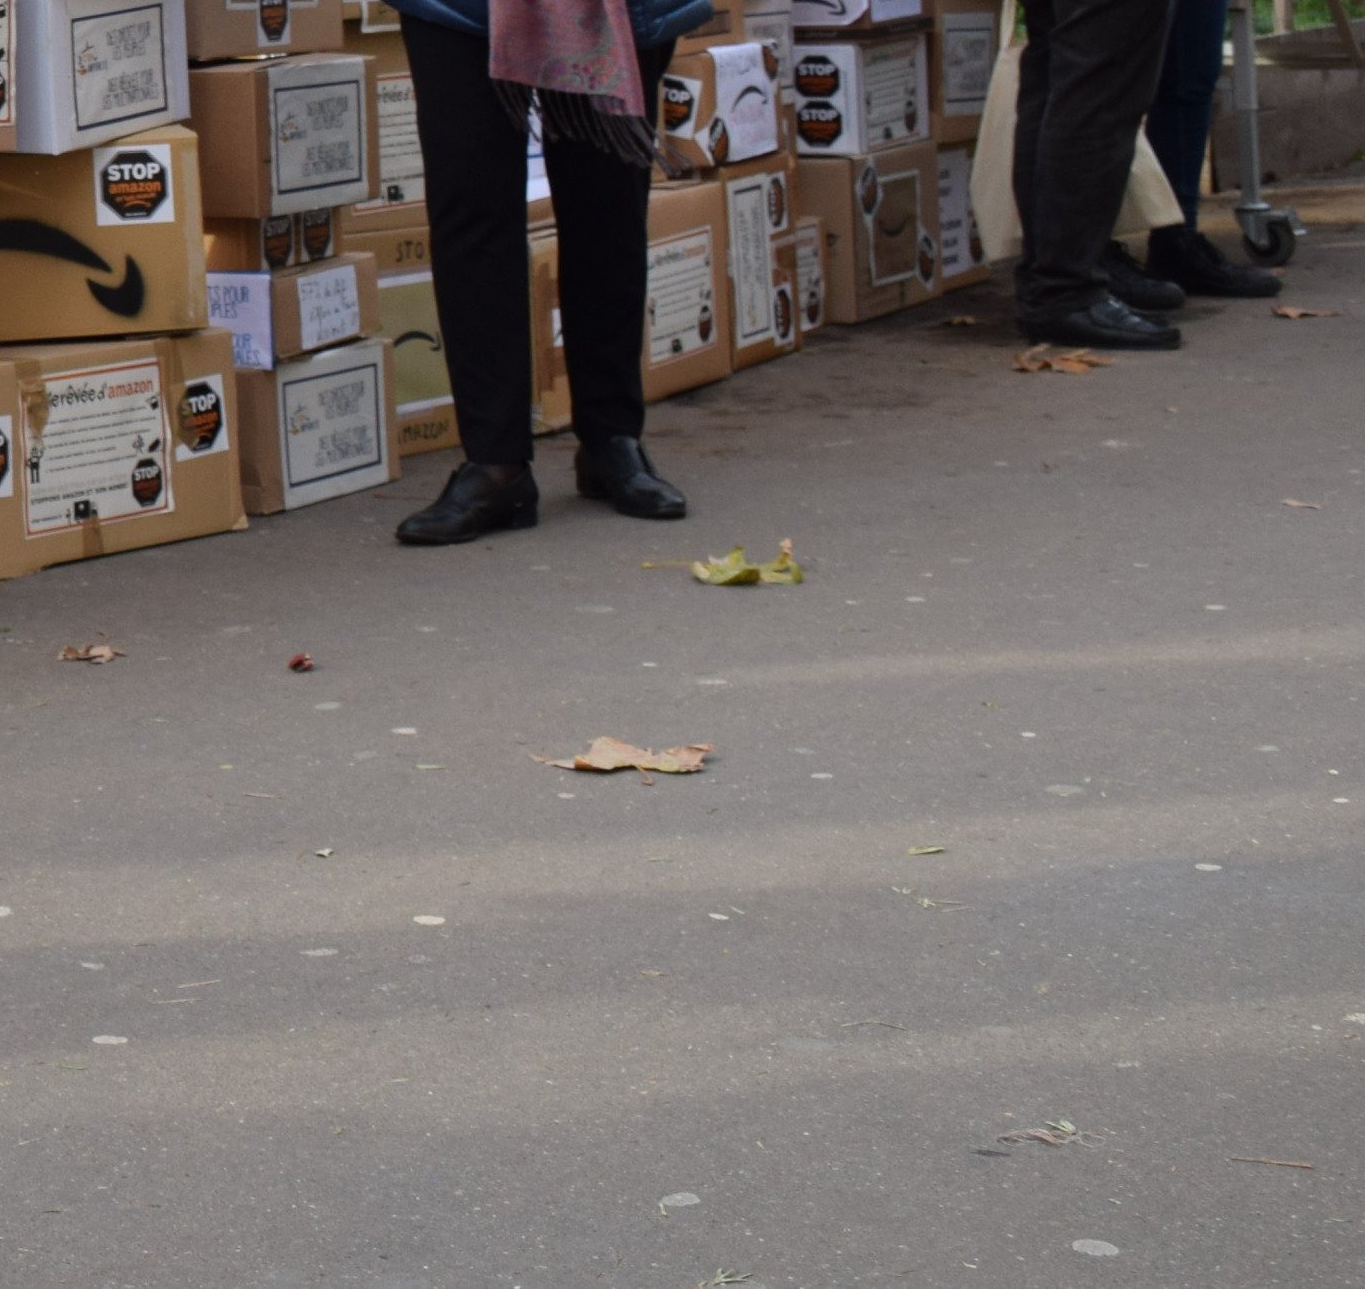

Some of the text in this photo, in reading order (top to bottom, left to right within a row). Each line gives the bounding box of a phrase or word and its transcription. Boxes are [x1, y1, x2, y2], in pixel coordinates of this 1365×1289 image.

[799, 64, 836, 76] STOP
[801, 110, 837, 121] STOP
[107, 163, 160, 181] STOP
[396, 240, 424, 262] STO
[134, 466, 159, 480] STOP
